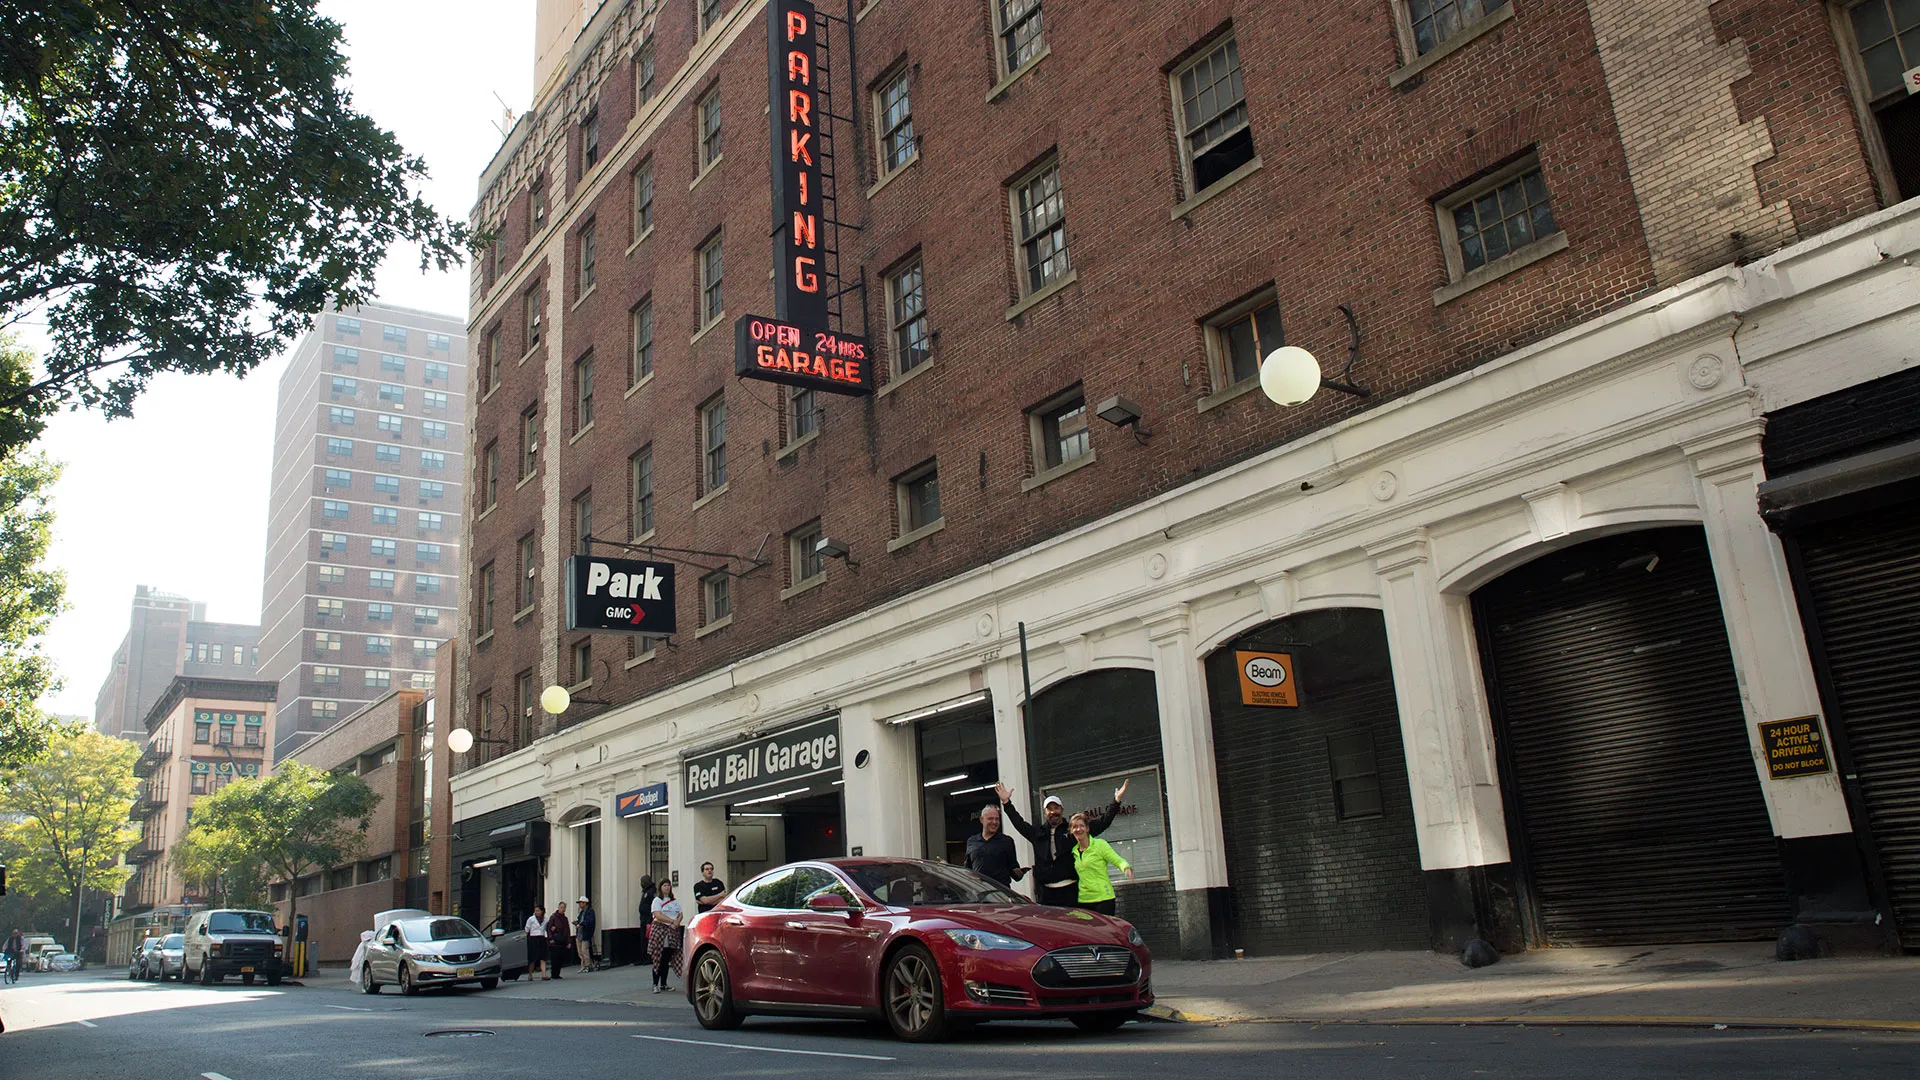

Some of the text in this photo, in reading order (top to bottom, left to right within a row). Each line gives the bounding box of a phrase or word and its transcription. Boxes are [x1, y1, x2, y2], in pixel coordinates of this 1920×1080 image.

[787, 10, 818, 292] PARKING
[750, 320, 800, 347] OPEN
[815, 333, 838, 354] 24
[757, 345, 861, 383] GARAGE
[587, 562, 664, 600] Park
[606, 606, 632, 619] GMC
[1251, 664, 1281, 679] Beam
[1770, 723, 1811, 738] 24 HOUR
[1777, 734, 1809, 747] ACTIVE
[1771, 743, 1819, 758] DRIVEWAY
[688, 734, 837, 794] Red Ball Garage
[1772, 758, 1825, 771] DO NOT BLOCK
[640, 790, 659, 806] Budget
